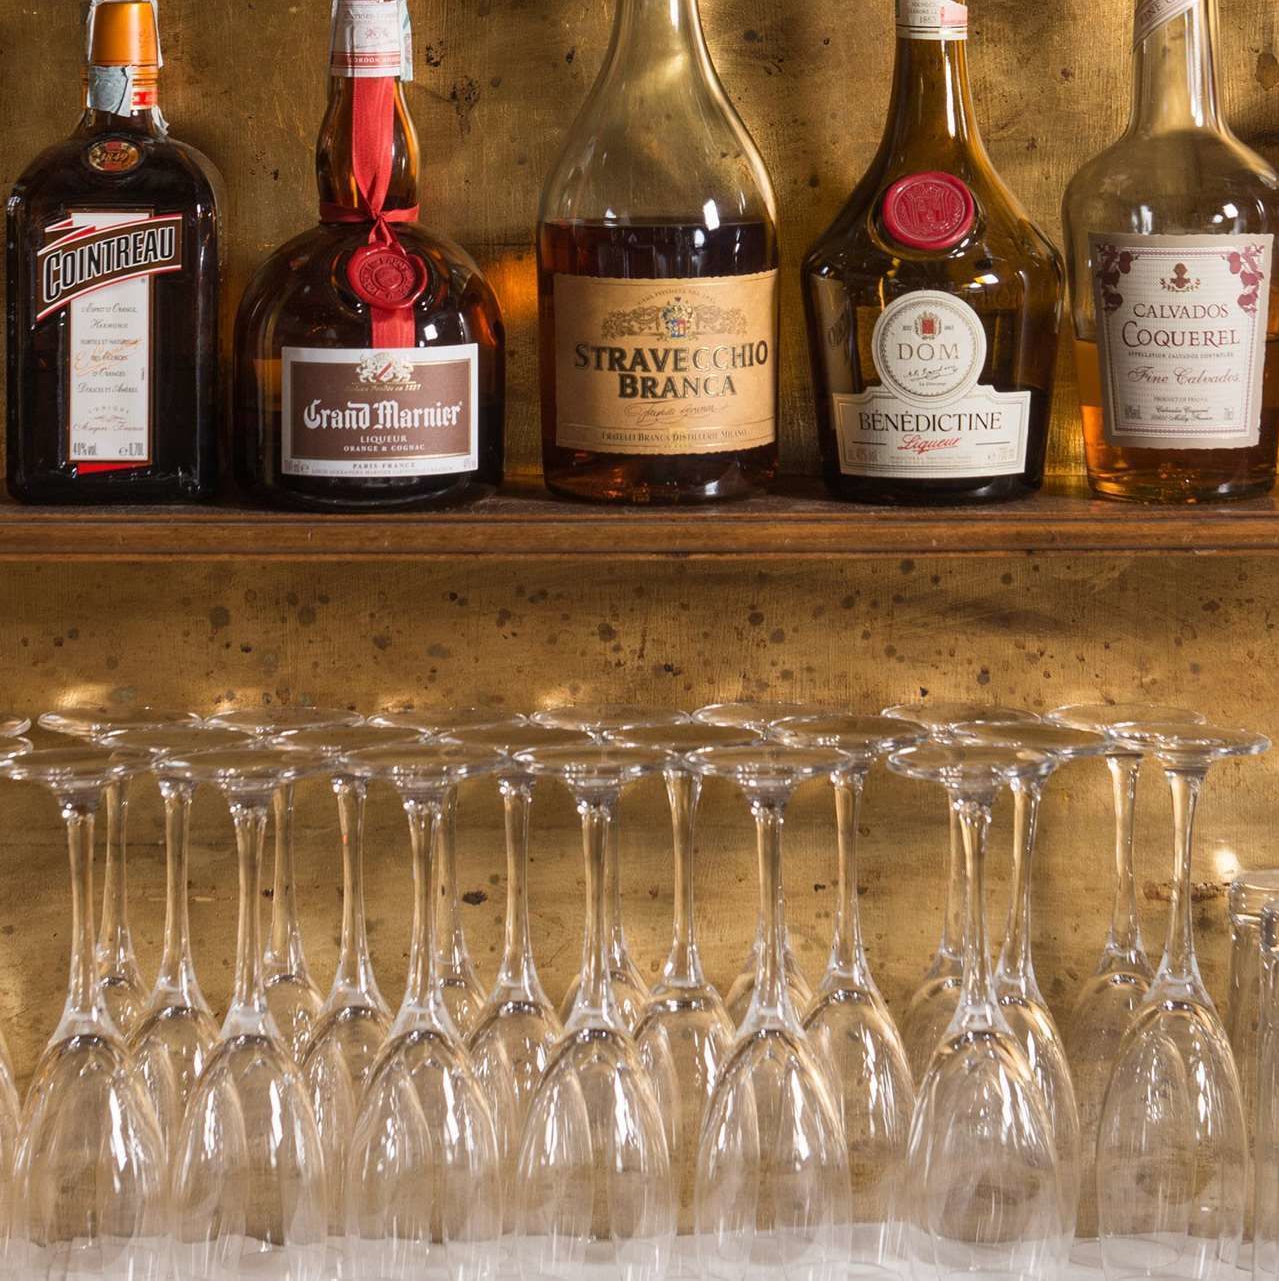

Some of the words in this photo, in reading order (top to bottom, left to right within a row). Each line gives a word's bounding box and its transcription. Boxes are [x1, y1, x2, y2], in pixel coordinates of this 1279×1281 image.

[43, 225, 176, 303] COINTREAU
[1133, 303, 1229, 319] CALVADOS
[1122, 320, 1240, 348] COQUEREL
[574, 340, 769, 373] STRAVECCHIO
[896, 342, 962, 362] DOM
[618, 373, 739, 400] BRANCA
[1128, 366, 1169, 384] Fine
[1173, 368, 1241, 385] Calvados
[303, 399, 370, 430] Grand
[372, 399, 462, 430] Marnier
[858, 409, 1002, 433] BÉNÉDICTINE
[359, 435, 408, 445] LIQUEUR
[601, 430, 637, 442] FRATELLI
[638, 432, 671, 441] BRANCA
[672, 431, 719, 441] DISTILLERIE
[720, 429, 748, 439] MILANO
[896, 433, 962, 455] Liqueur
[343, 445, 380, 453] ORANGE
